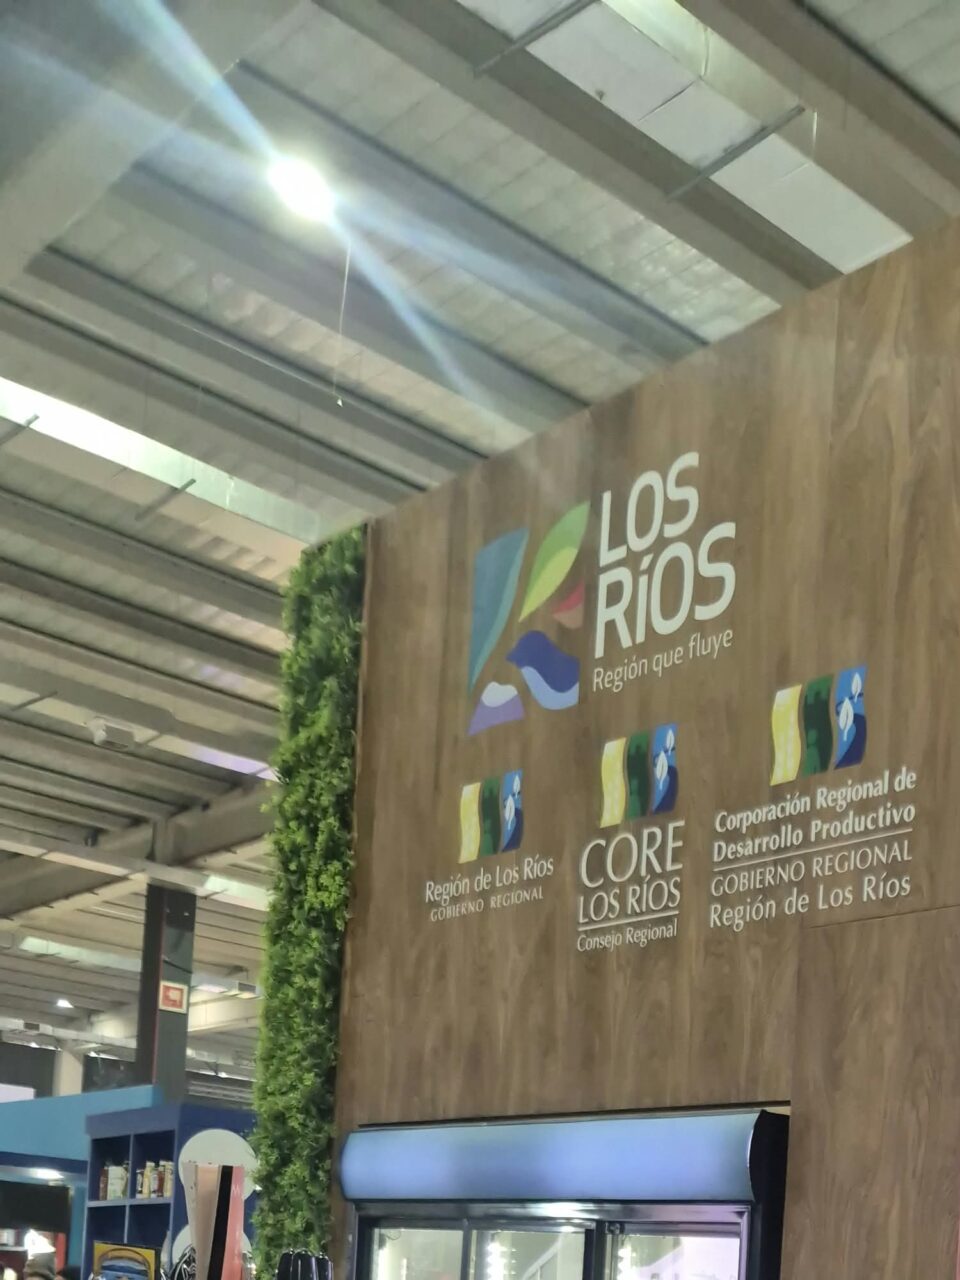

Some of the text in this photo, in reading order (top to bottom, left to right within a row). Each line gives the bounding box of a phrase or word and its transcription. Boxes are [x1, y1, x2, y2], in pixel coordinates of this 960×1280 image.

[599, 451, 700, 567] LOS
[593, 629, 734, 694] Región que fluye
[715, 766, 917, 835] Corporación Regional de
[581, 820, 685, 888] CORE
[713, 802, 916, 863] Desarrollo Productivo
[425, 854, 554, 907] Región de Los Ríos
[711, 840, 912, 897] GOBIERNO REGIONAL
[430, 886, 544, 922] GOBIERNO REGIONAL
[579, 874, 681, 924] LOS RÍOS
[710, 872, 911, 932] Región de Los Ríos
[577, 917, 678, 952] Consejo Regional
